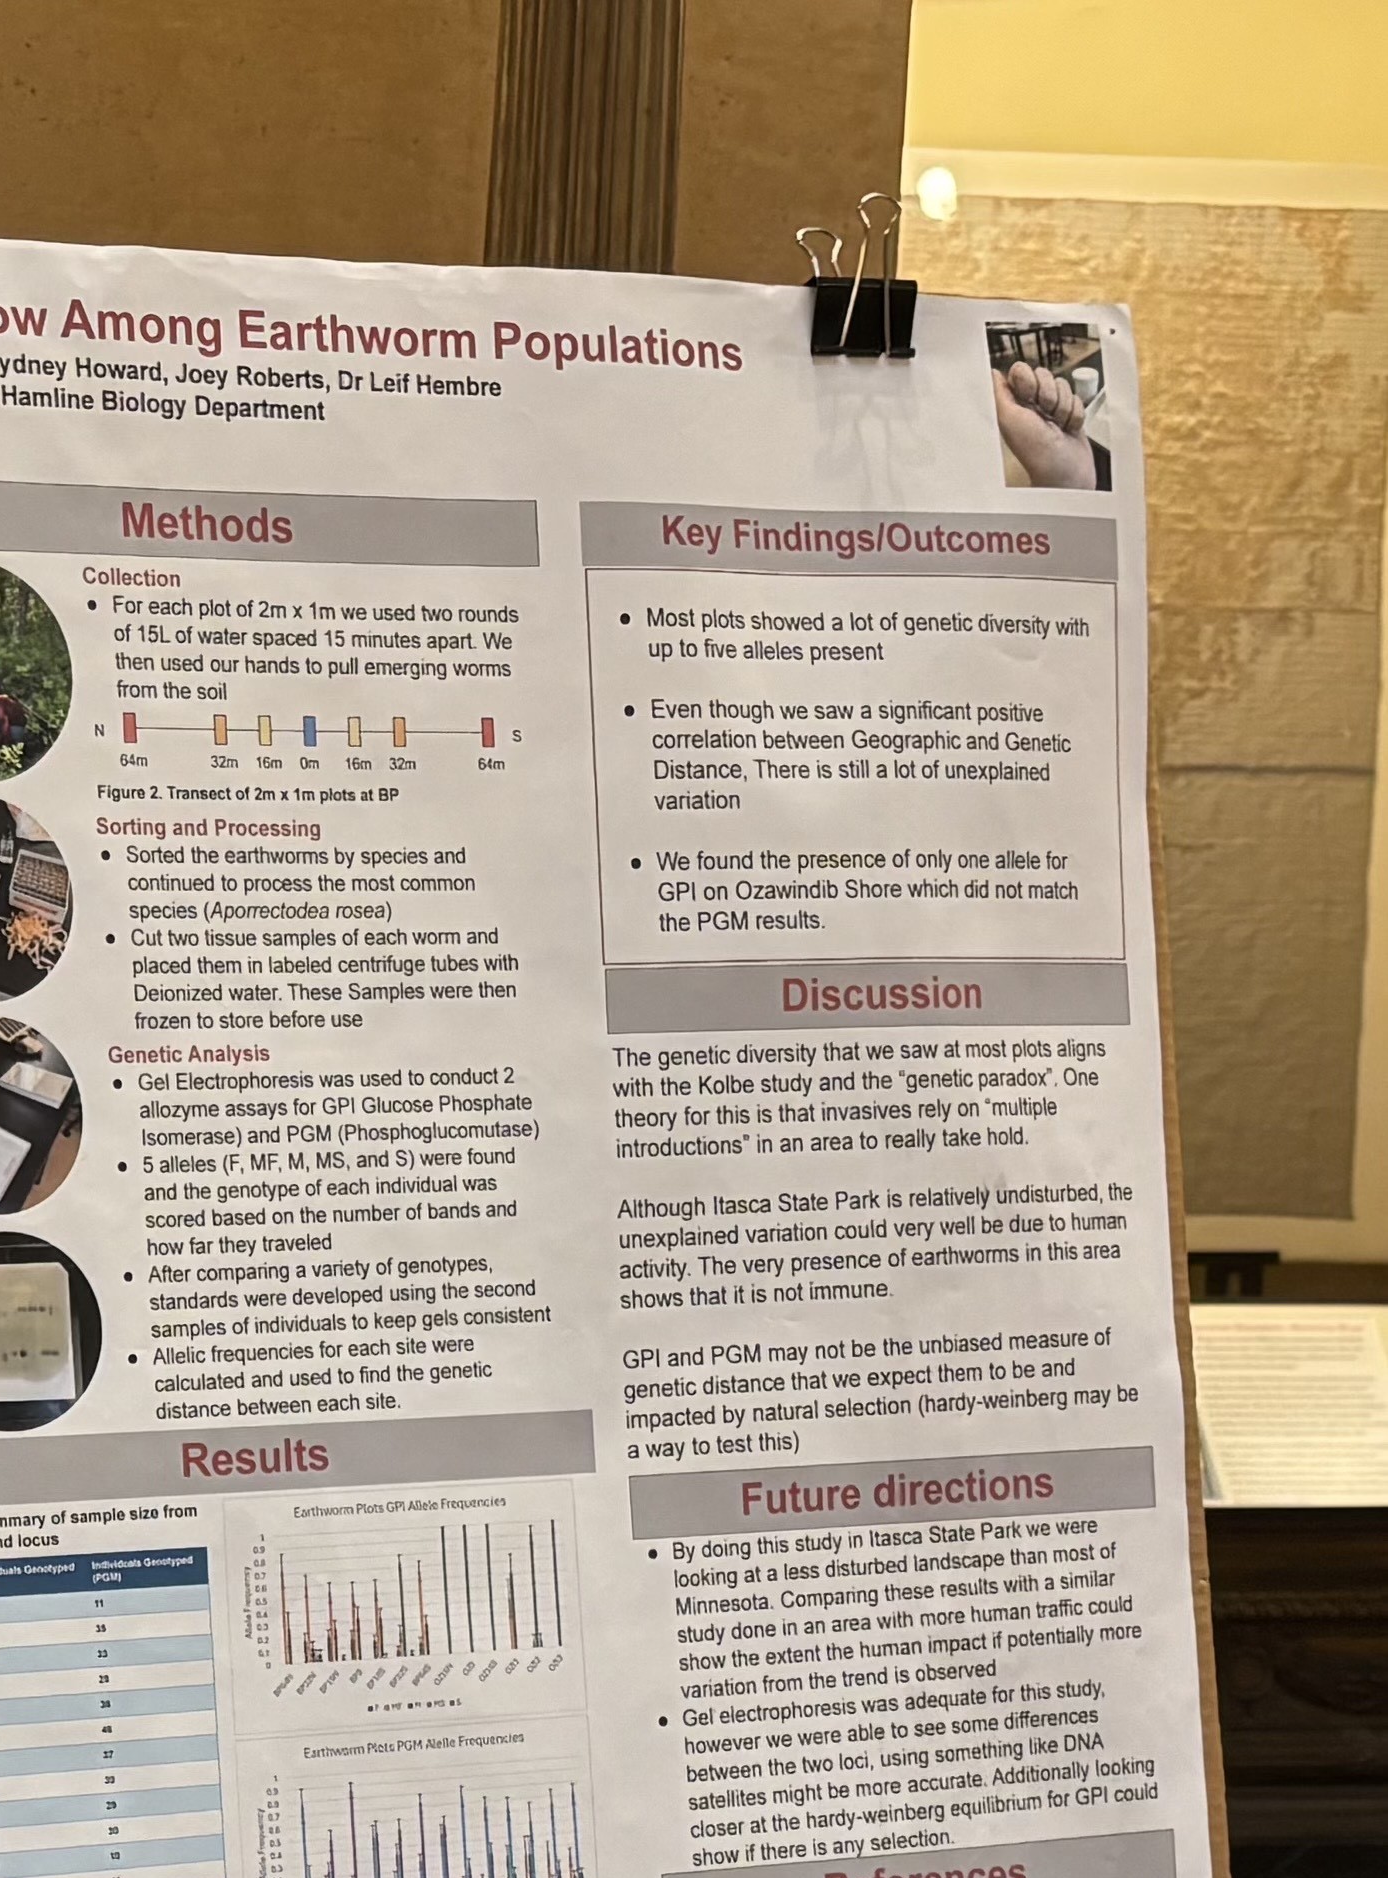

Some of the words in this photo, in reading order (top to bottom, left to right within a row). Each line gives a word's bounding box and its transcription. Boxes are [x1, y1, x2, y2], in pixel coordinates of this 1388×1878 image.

[60, 298, 222, 358] Among
[238, 309, 477, 360] Earthworm
[493, 321, 743, 372] Populations
[75, 356, 169, 387] Howard,
[174, 362, 229, 391] Joey
[236, 365, 331, 394] Roberts,
[337, 369, 364, 392] Dr
[369, 371, 410, 394] Leif
[416, 373, 502, 397] Hembre
[0, 384, 95, 410] Hamline
[101, 389, 187, 421] Biology
[194, 394, 326, 423] Department
[121, 501, 293, 544] Methods
[661, 514, 723, 556] Key
[732, 518, 1051, 561] Findings/Outcomes
[82, 566, 181, 588] Collection
[646, 607, 696, 628] Most
[701, 608, 746, 633] plots
[750, 610, 825, 632] showed
[831, 616, 844, 632] a
[849, 611, 874, 632] lot
[879, 611, 899, 632] of
[903, 612, 974, 636] genetic
[977, 613, 1051, 640] diversity
[1055, 617, 1090, 638] with
[94, 723, 105, 737] N
[512, 729, 523, 743] S
[119, 753, 148, 768] 64m
[210, 754, 239, 769] 32m
[256, 756, 283, 770] 16m
[299, 756, 320, 770] 0m
[345, 756, 372, 771] 16m
[389, 756, 417, 771] 32m
[477, 757, 506, 771] 64m
[97, 784, 146, 803] Figure
[149, 785, 163, 800] 2.
[166, 785, 232, 801] Transect
[235, 786, 250, 801] of
[254, 786, 276, 801] 2m
[279, 790, 290, 802] x
[293, 787, 316, 802] 1m
[319, 787, 357, 805] plots
[360, 788, 374, 802] at
[378, 787, 400, 802] BP
[96, 816, 167, 841] Sorting
[172, 818, 208, 837] and
[214, 818, 321, 842] Processing
[782, 974, 982, 1012] Discussion
[107, 1044, 183, 1064] Genetic
[187, 1043, 271, 1067] Analysis
[619, 1289, 684, 1310] shows
[689, 1285, 728, 1307] that
[733, 1285, 746, 1305] it
[750, 1283, 768, 1304] is
[773, 1282, 804, 1303] not
[808, 1281, 893, 1301] immune.
[181, 1437, 330, 1479] Results
[741, 1480, 862, 1517] Future
[873, 1468, 1054, 1509] directions
[50, 1509, 67, 1525] of
[70, 1507, 126, 1526] sample
[129, 1506, 159, 1521] size
[162, 1504, 198, 1519] from
[17, 1533, 60, 1548] locus
[680, 1677, 758, 1699] variation
[762, 1674, 803, 1694] from
[808, 1671, 837, 1690] the
[841, 1666, 889, 1688] trend
[894, 1665, 911, 1685] is
[915, 1658, 997, 1683] observed
